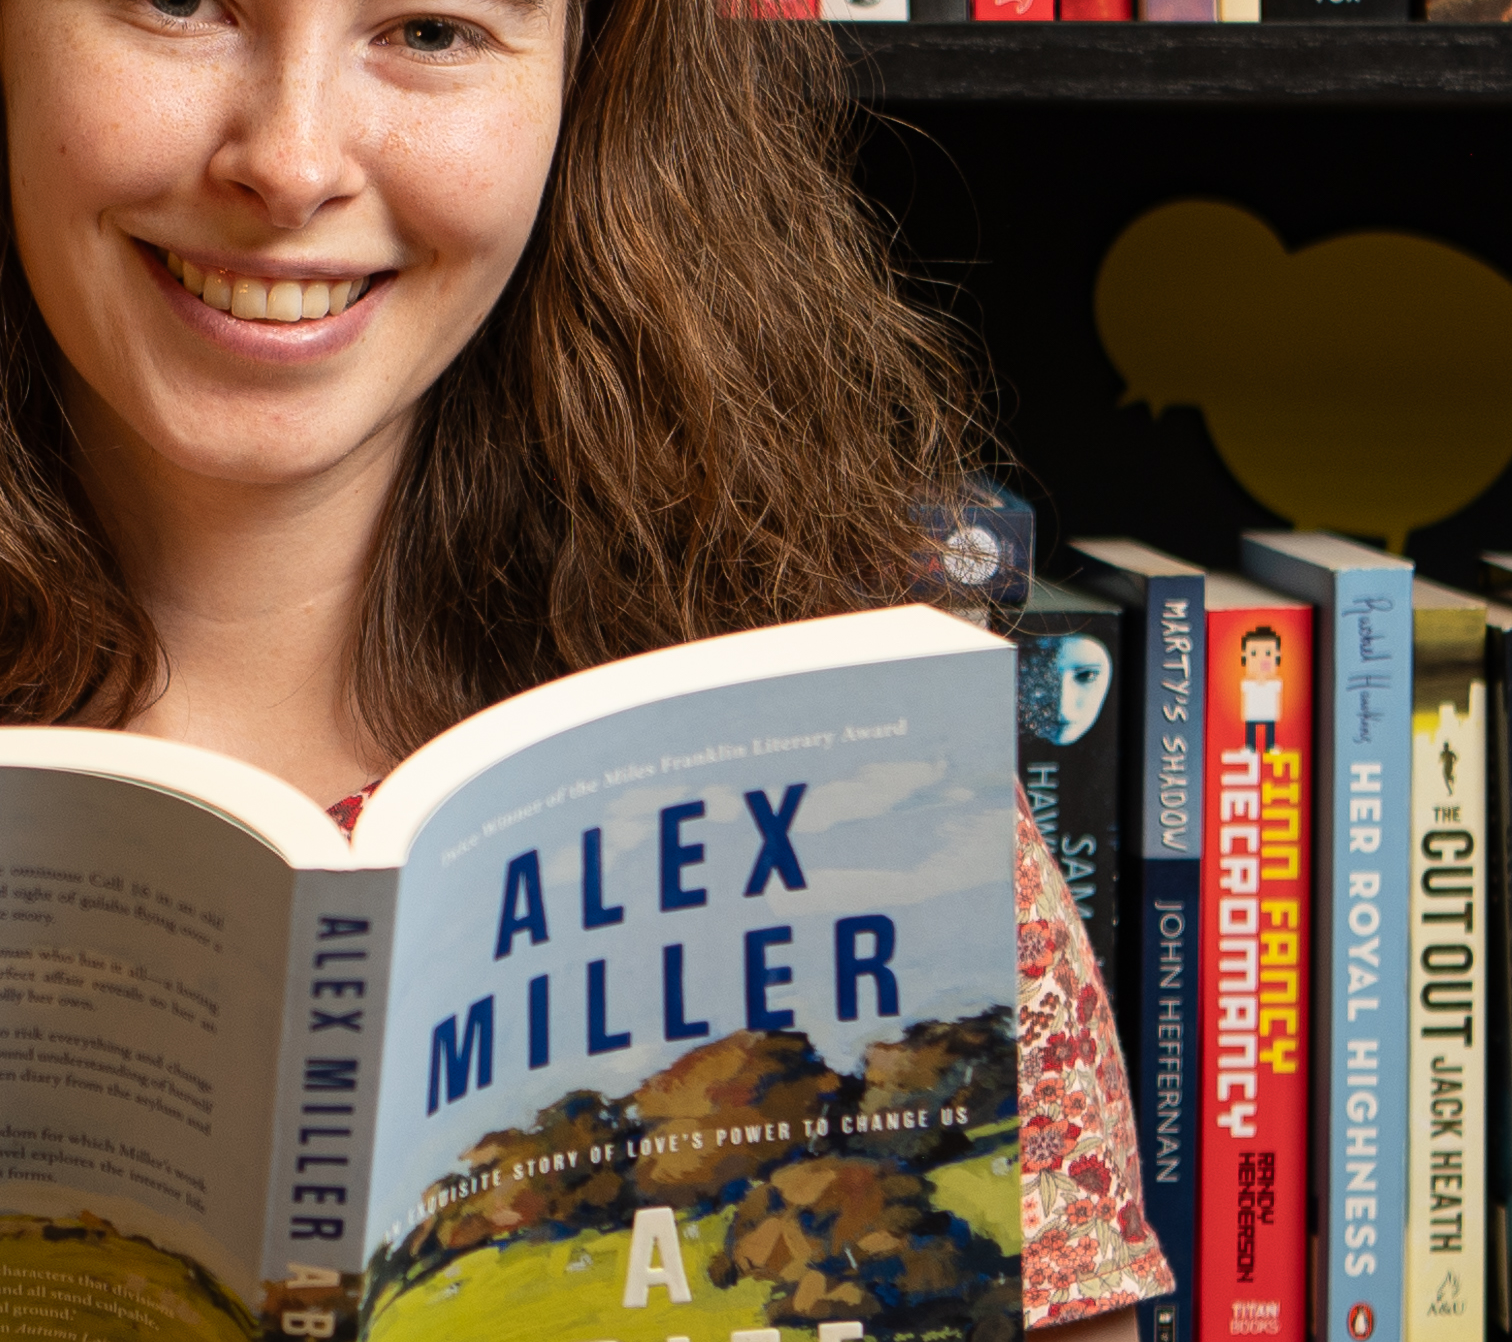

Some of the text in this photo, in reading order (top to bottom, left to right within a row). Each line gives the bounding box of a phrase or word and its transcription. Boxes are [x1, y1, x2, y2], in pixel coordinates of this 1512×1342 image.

[1162, 598, 1190, 850] MARTY'S SHADOW
[1434, 804, 1461, 823] THE
[494, 783, 808, 961] ALEX
[1421, 828, 1472, 1048] CUT OUT
[309, 915, 371, 1032] ALEX
[427, 914, 901, 1116] MILLER
[1156, 902, 1184, 1183] JOHN HEFFERNAN
[1346, 763, 1382, 1278] HER ROYAL HIGHNESS
[290, 1058, 360, 1241] MILLER
[513, 1152, 578, 1180] STORY
[591, 1144, 616, 1163] OF
[627, 1131, 704, 1158] LOVE'S
[717, 1123, 790, 1147] POWER
[802, 1118, 828, 1139] TO
[842, 1110, 929, 1134] CHANGE
[941, 1107, 969, 1126] US
[1430, 1057, 1462, 1253] JACK HEATH
[286, 1262, 341, 1289] A
[623, 1207, 691, 1307] A
